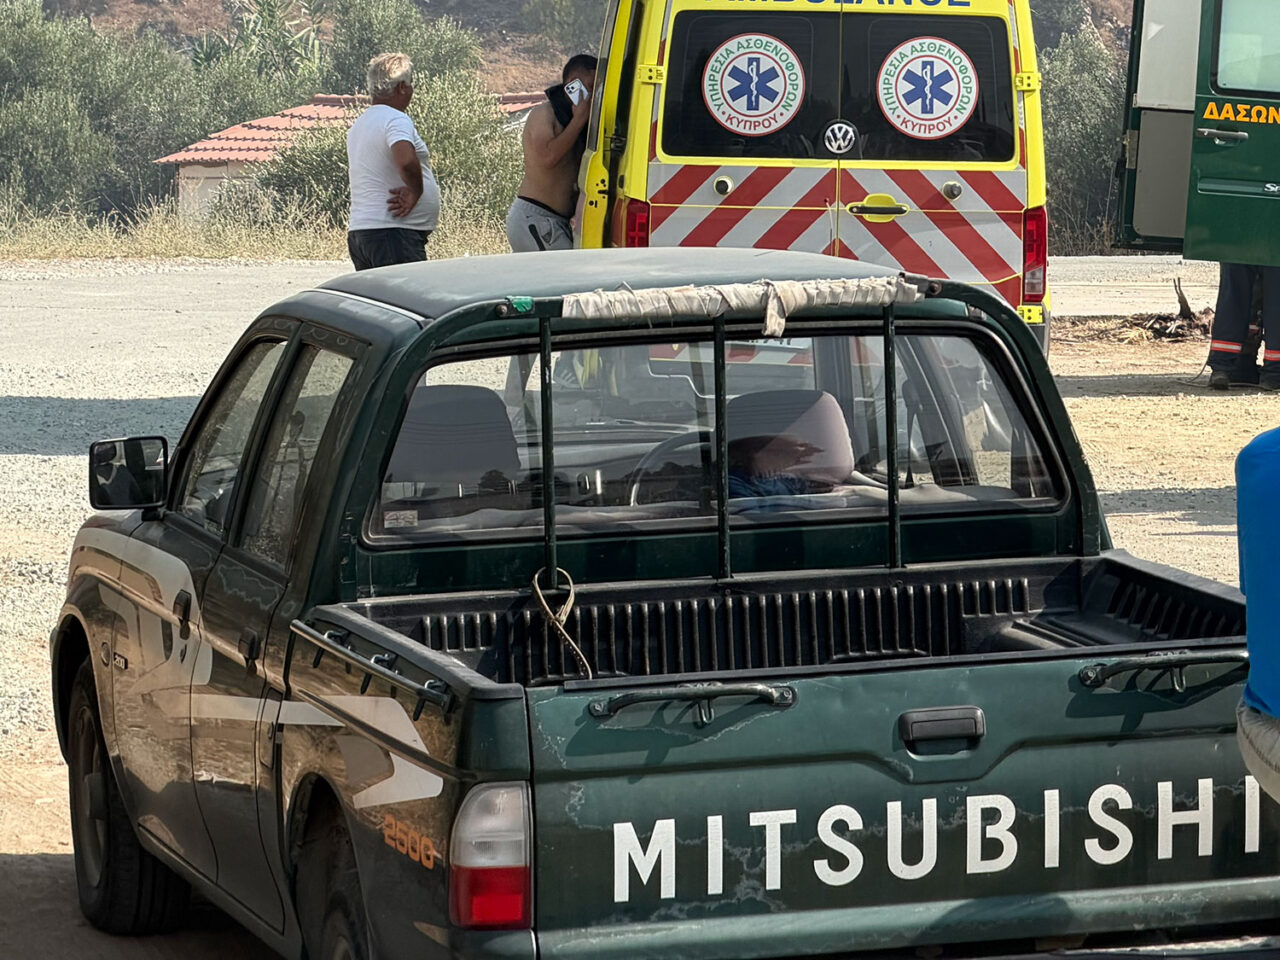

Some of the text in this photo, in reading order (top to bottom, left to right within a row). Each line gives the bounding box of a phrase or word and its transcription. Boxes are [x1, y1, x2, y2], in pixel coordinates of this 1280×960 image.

[708, 38, 799, 112] ΥΠΗΡΕΣΙΑ ΑΣΘΕΝΟΦΟΡΩΝ
[882, 42, 973, 115] ΥΠΗΡΕΣΙΑ ΑΣΘΕΝΟΦΟΡΩΝ
[725, 113, 779, 131] ΚΥΠΡΟΥ
[899, 116, 953, 134] ΚΥΠΡΟΥ
[612, 775, 1260, 903] MITSUBISHI
